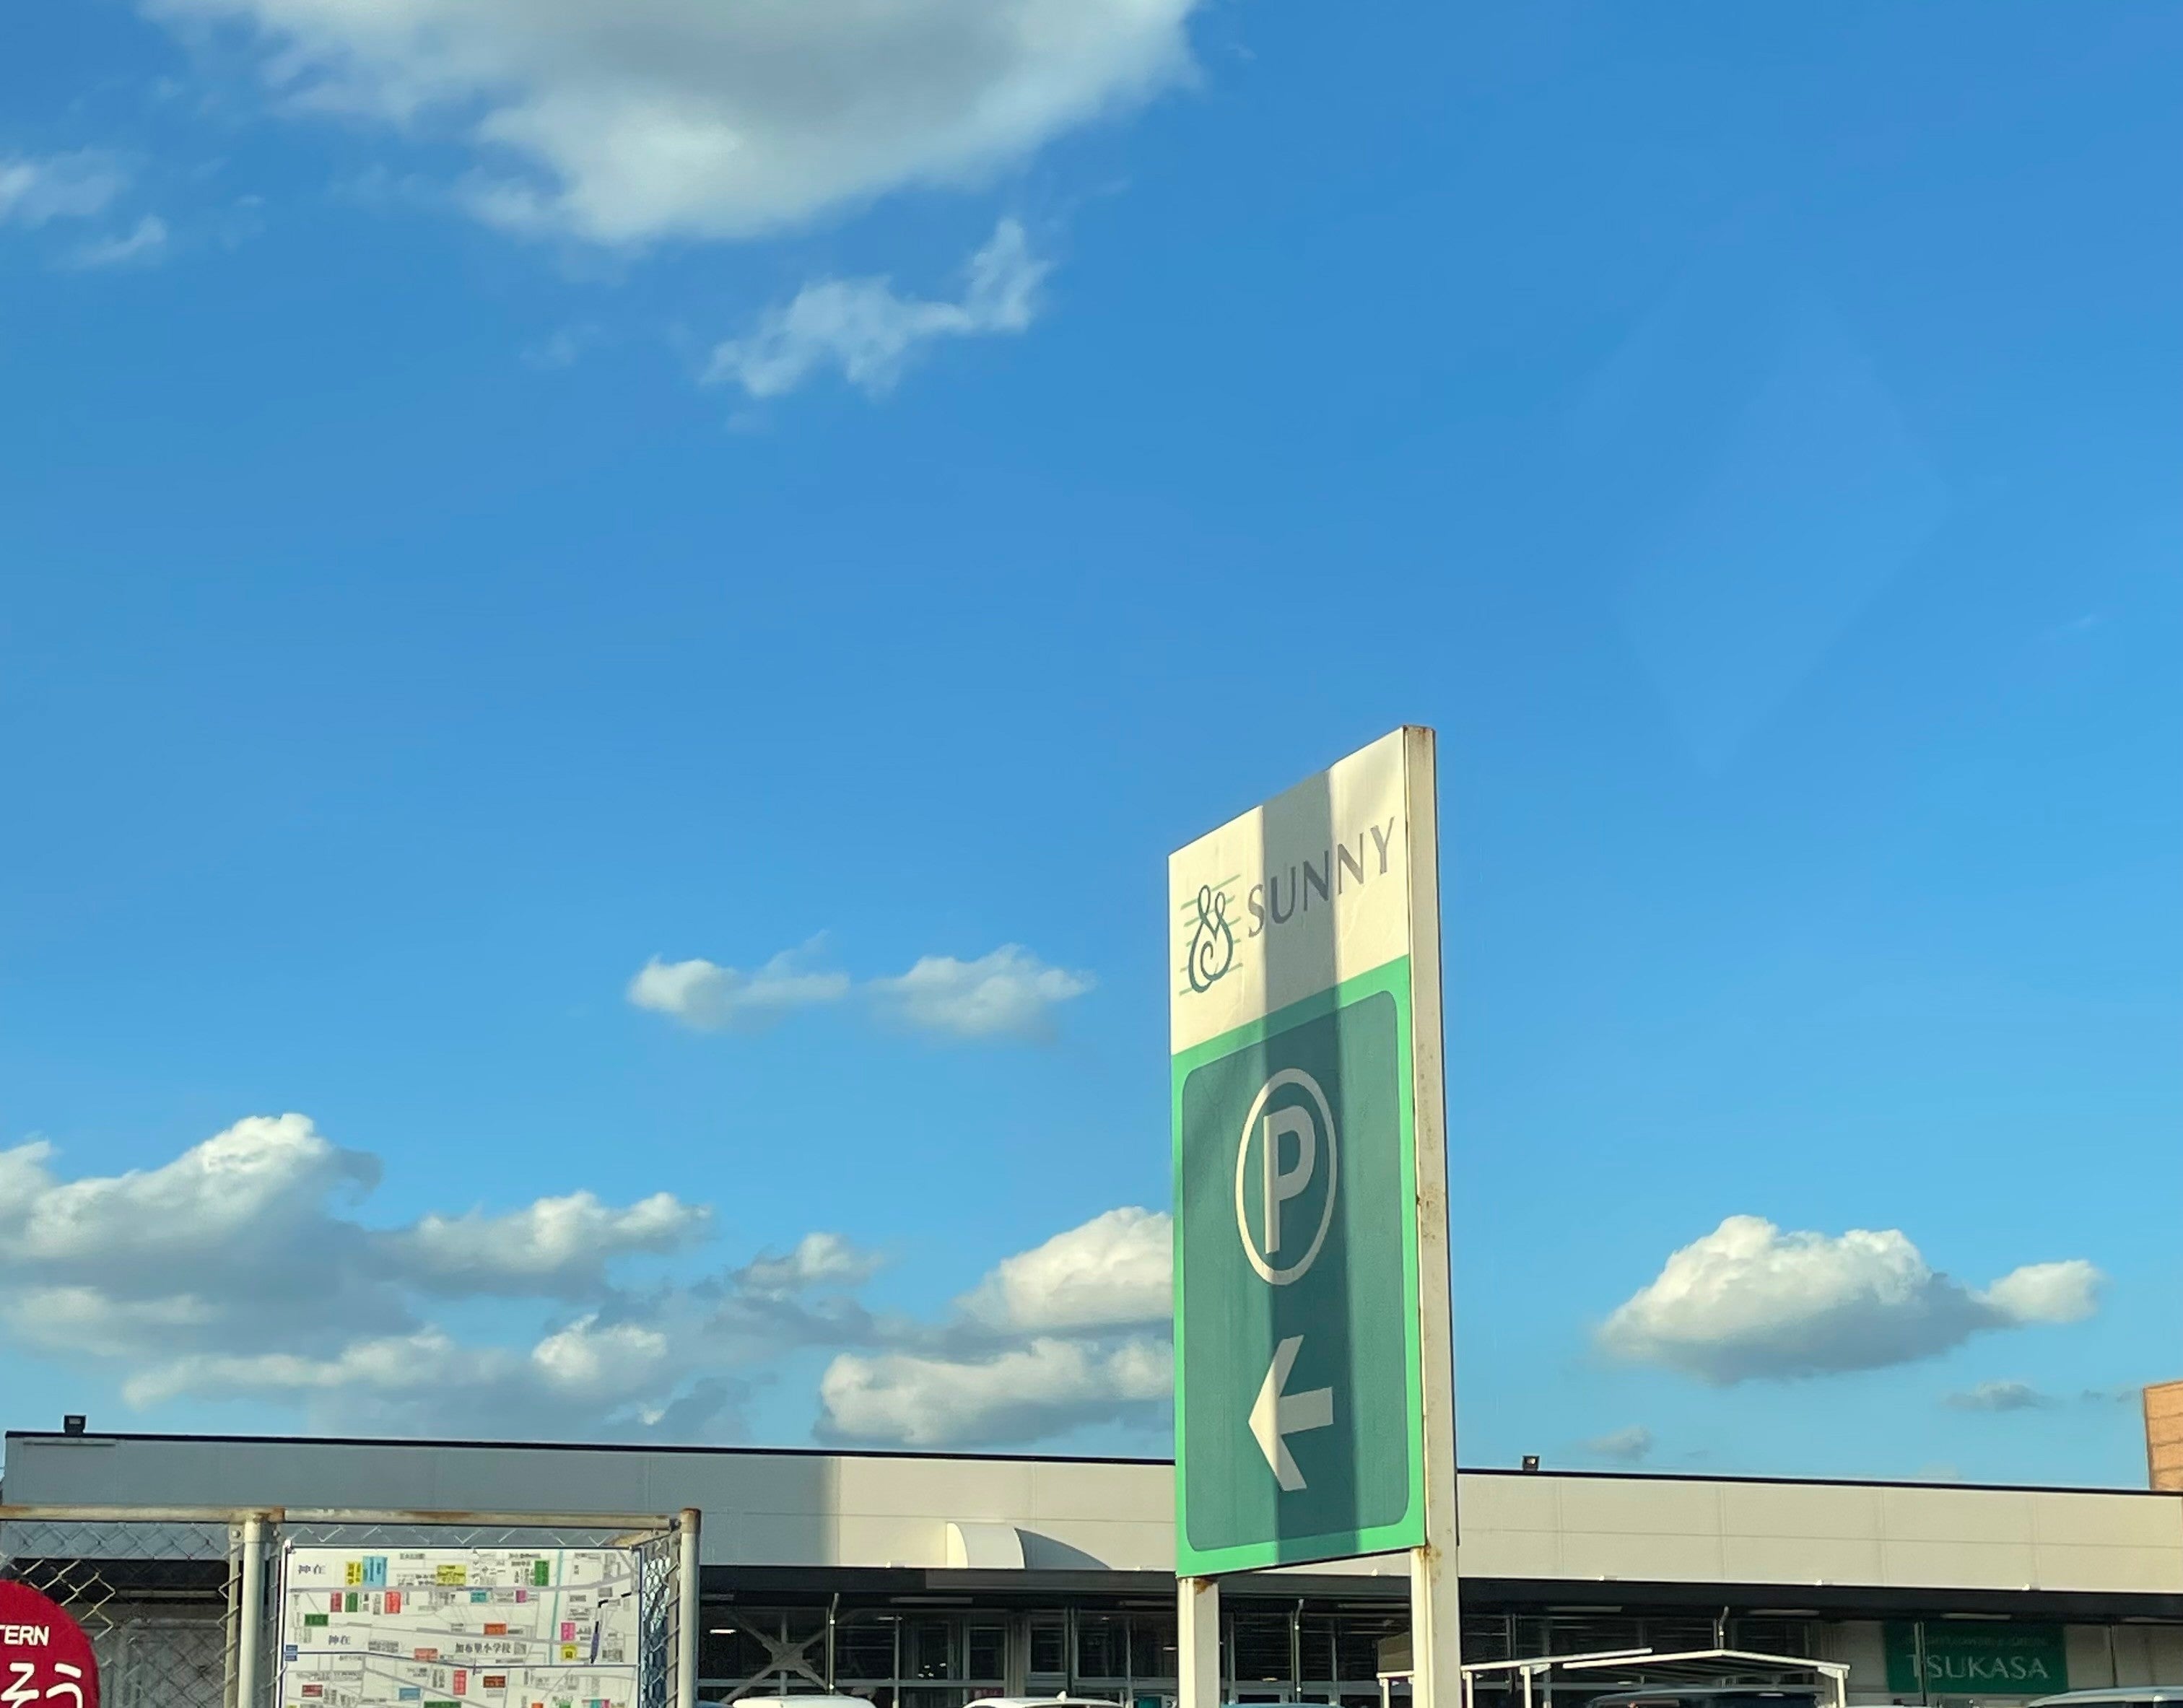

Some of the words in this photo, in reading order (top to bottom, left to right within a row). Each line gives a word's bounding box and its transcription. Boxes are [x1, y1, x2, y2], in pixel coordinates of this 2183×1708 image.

[1247, 816, 1395, 938] SUNNY
[1263, 1104, 1316, 1255] P
[1906, 1654, 2050, 1680] TSUKASA
